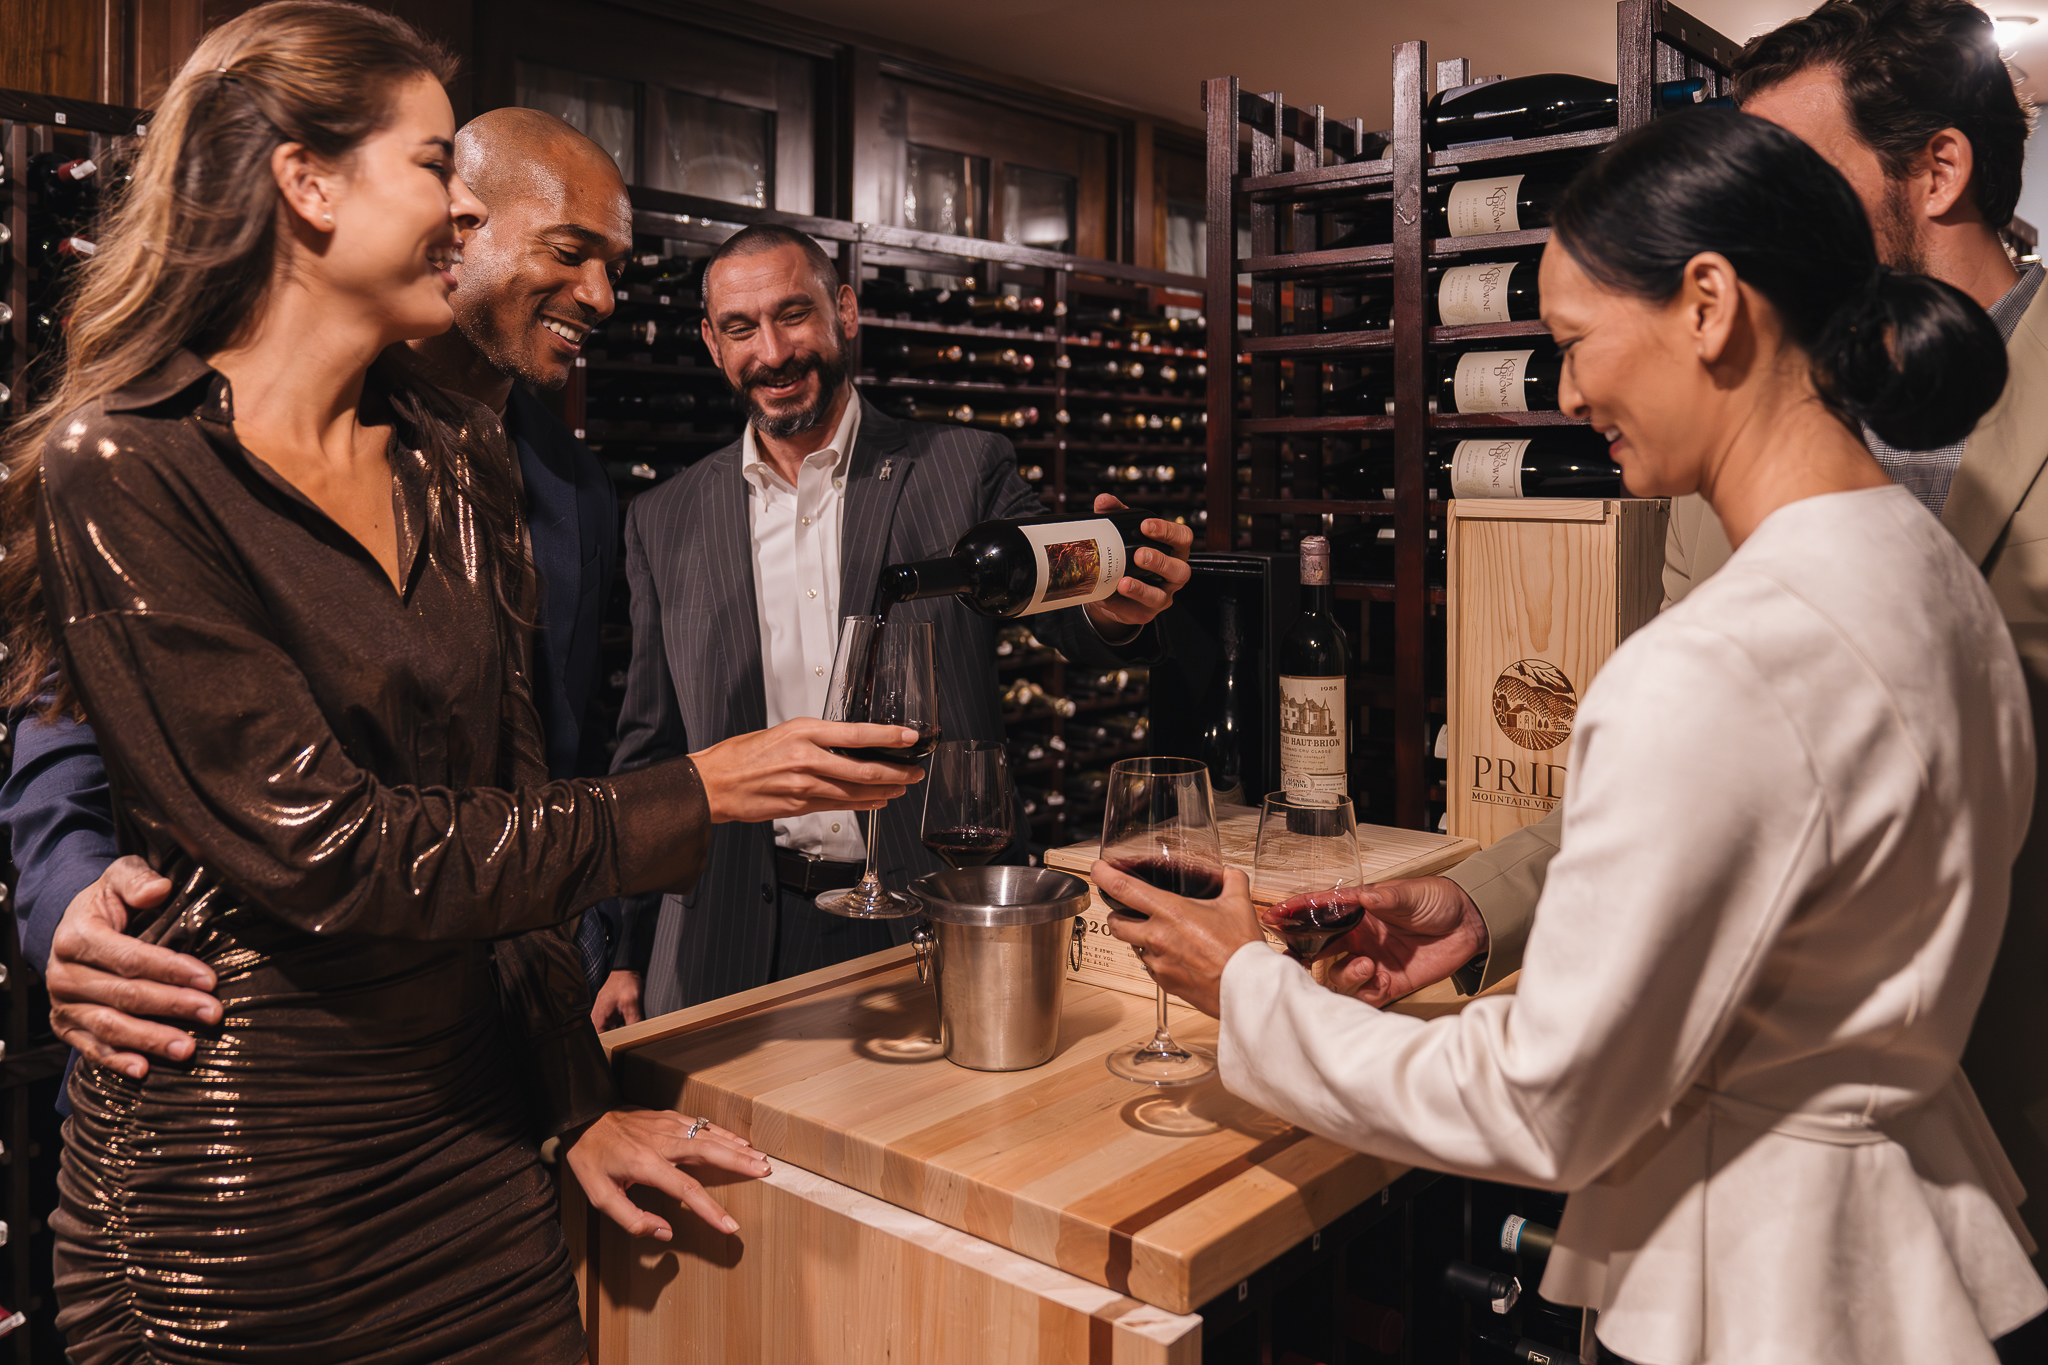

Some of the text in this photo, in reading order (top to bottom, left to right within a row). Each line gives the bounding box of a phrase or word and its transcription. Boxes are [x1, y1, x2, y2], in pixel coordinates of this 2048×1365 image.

[1493, 186, 1508, 217] KOSTA
[1478, 273, 1493, 312] BROWNE
[1486, 266, 1504, 291] KOSTA
[1493, 366, 1509, 407] BROWNE
[1501, 358, 1518, 387] KOSTA
[1488, 447, 1501, 488] BROWNE
[1497, 441, 1515, 468] KOSTA
[1104, 546, 1113, 584] Aperture
[1472, 792, 1530, 807] MOUNTAIN
